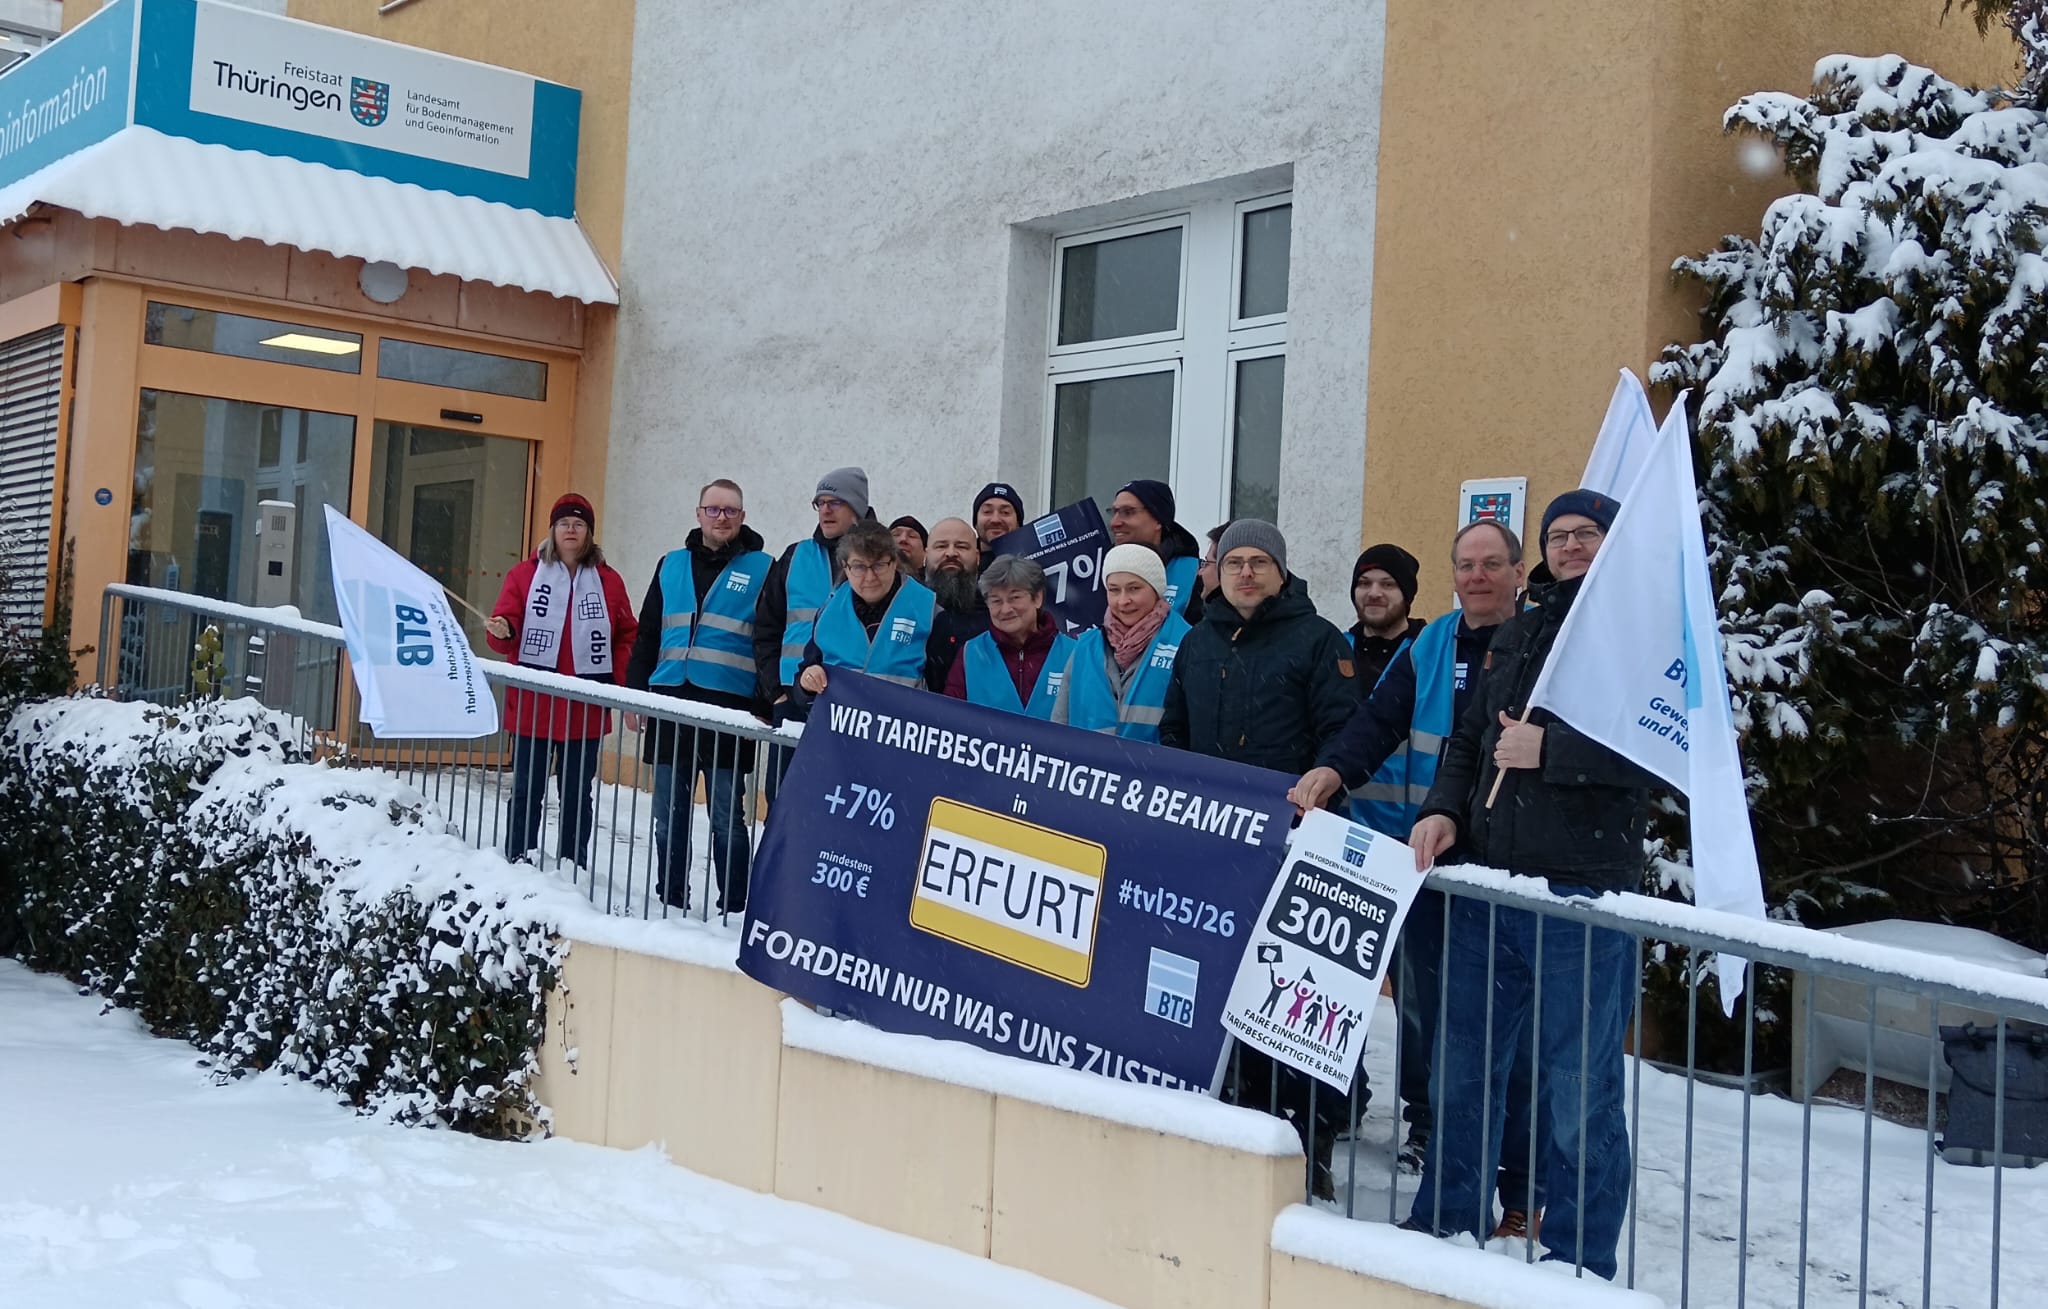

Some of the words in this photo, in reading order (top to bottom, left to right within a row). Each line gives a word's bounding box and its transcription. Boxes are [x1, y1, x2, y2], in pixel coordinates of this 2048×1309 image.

[213, 60, 341, 111] Thüringen
[284, 62, 343, 87] Freistaat
[407, 89, 460, 110] Landesamt
[405, 119, 424, 129] und
[426, 121, 500, 145] Geoinformation
[406, 103, 419, 114] für
[421, 106, 514, 135] Bodenmanagement
[532, 584, 551, 617] dbb
[591, 630, 606, 665] dbb
[1638, 713, 1673, 737] und
[829, 703, 874, 739] WIR
[876, 714, 1121, 804] TARIFBESCHÄFTIGTE
[1121, 779, 1144, 812] &
[1146, 785, 1270, 847] BEAMTE
[824, 783, 895, 831] +7%
[1012, 793, 1027, 815] in
[819, 850, 873, 874] mindestens
[1346, 849, 1366, 868] BTB
[811, 862, 851, 893] 300
[855, 875, 870, 898] €
[922, 838, 1095, 939] ERFURT
[1118, 879, 1236, 938] #tvl25/26
[1295, 871, 1387, 924] mindestens
[1278, 895, 1351, 955] 300
[1354, 929, 1379, 970] €
[747, 919, 890, 998] FORDERN
[891, 972, 950, 1021] NUR
[953, 993, 1012, 1044] WAS
[1018, 1018, 1077, 1069] UNS
[1157, 991, 1193, 1025] BTB
[1244, 1009, 1271, 1029] FAIRE
[1271, 1024, 1328, 1056] EINKOMMEN
[1328, 1050, 1343, 1064] FÜR
[1315, 1060, 1322, 1070] &
[1322, 1063, 1349, 1086] BEAMTE
